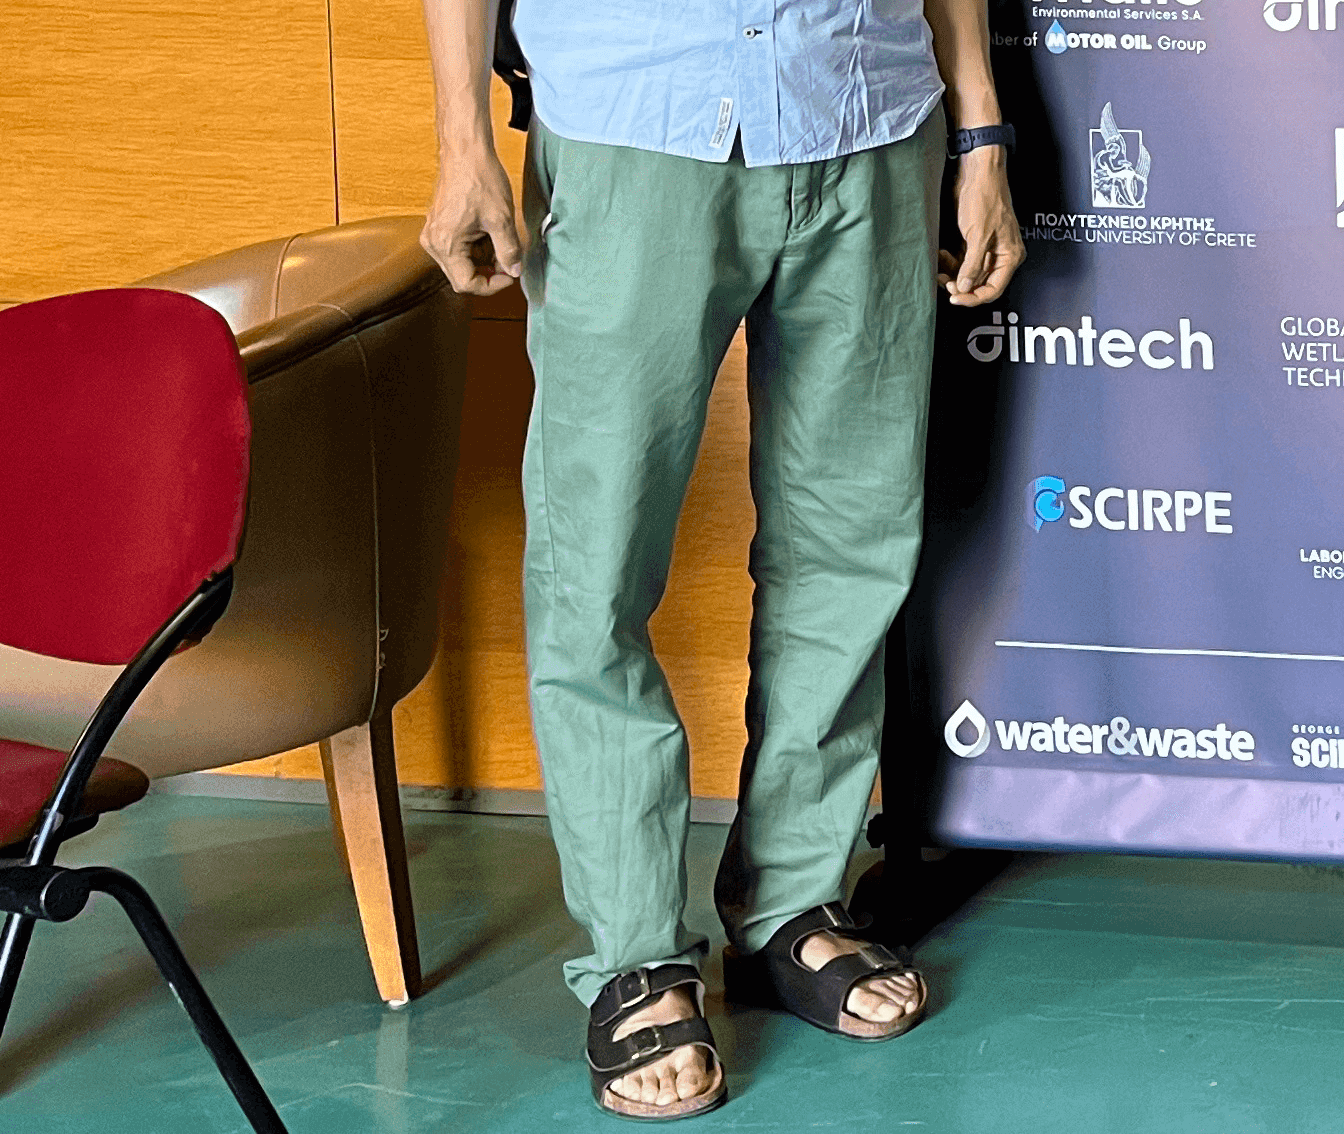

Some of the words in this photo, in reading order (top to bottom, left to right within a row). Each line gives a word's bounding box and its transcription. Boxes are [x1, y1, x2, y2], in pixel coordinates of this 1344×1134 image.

[1033, 7, 1120, 18] Environmental
[1124, 9, 1177, 20] Services
[1182, 10, 1204, 20] S.A.
[1024, 32, 1037, 46] of
[1048, 33, 1117, 49] MOTOR
[1121, 34, 1152, 49] OIL
[1158, 36, 1206, 54] Group
[1035, 214, 1147, 230] ΠΟΛΥΤΕΧΝΕΙΟ
[1151, 217, 1215, 231] ΚΡΗΤΗΣ
[1085, 231, 1175, 245] UNIVERSITY
[1178, 232, 1201, 245] OF
[1204, 233, 1257, 248] CRETE
[967, 310, 1214, 371] dimtech
[1069, 486, 1232, 533] SCIRPE
[1292, 725, 1339, 734] GEORGE
[994, 717, 1256, 764] water&waste
